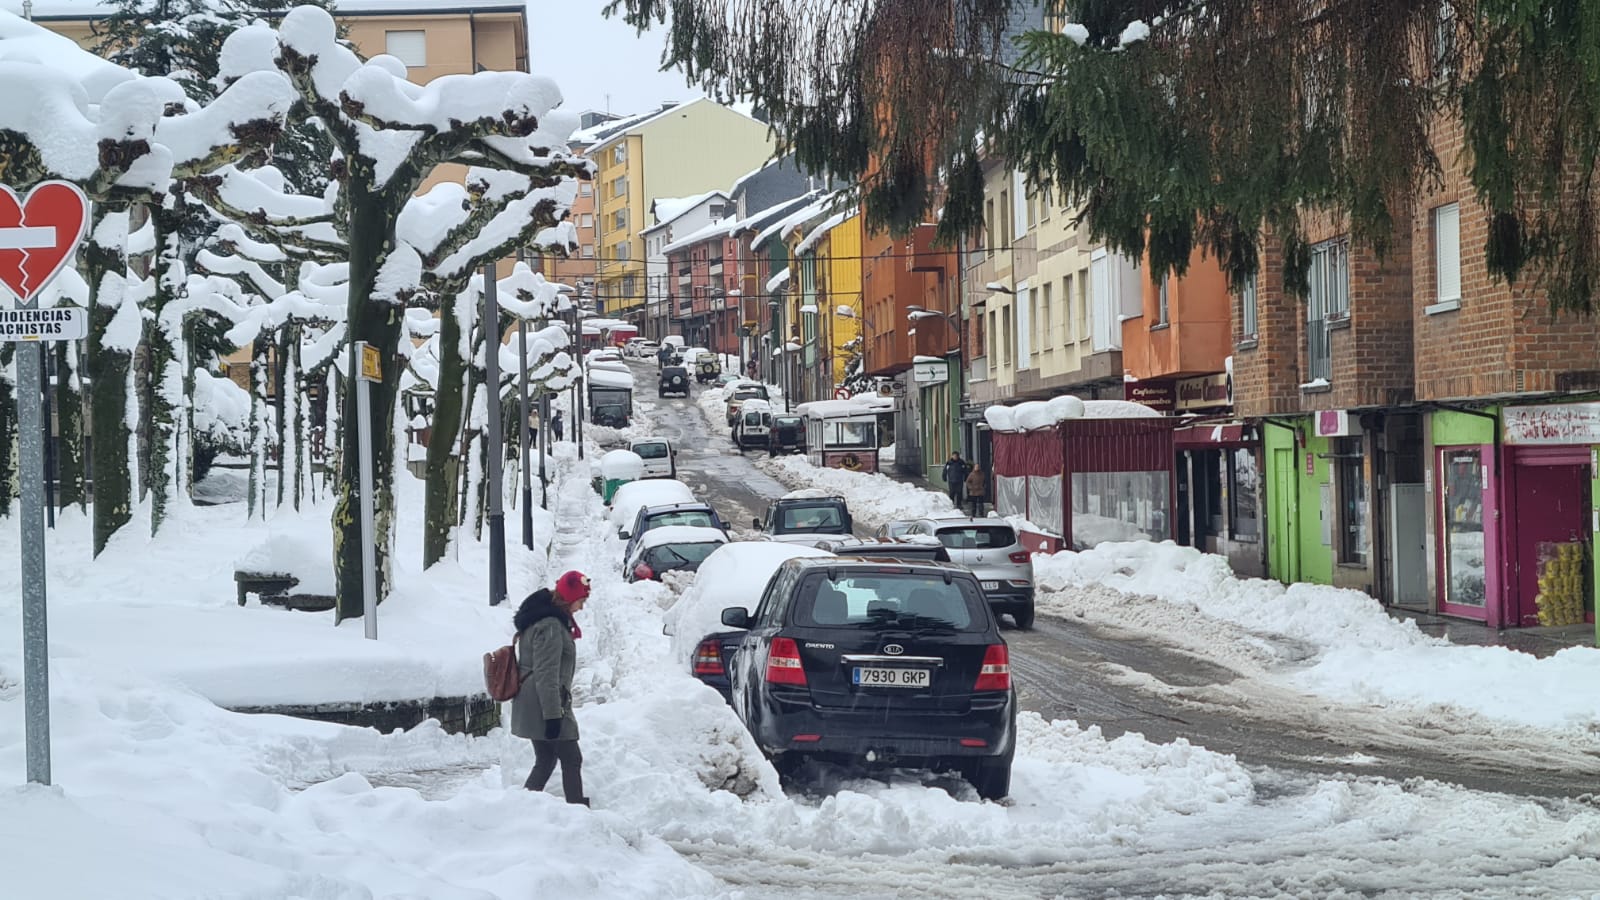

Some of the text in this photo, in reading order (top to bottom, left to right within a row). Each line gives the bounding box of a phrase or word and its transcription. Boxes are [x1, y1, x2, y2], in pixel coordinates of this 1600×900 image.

[886, 645, 902, 654] KIA
[863, 670, 926, 684] 7930 GKP
